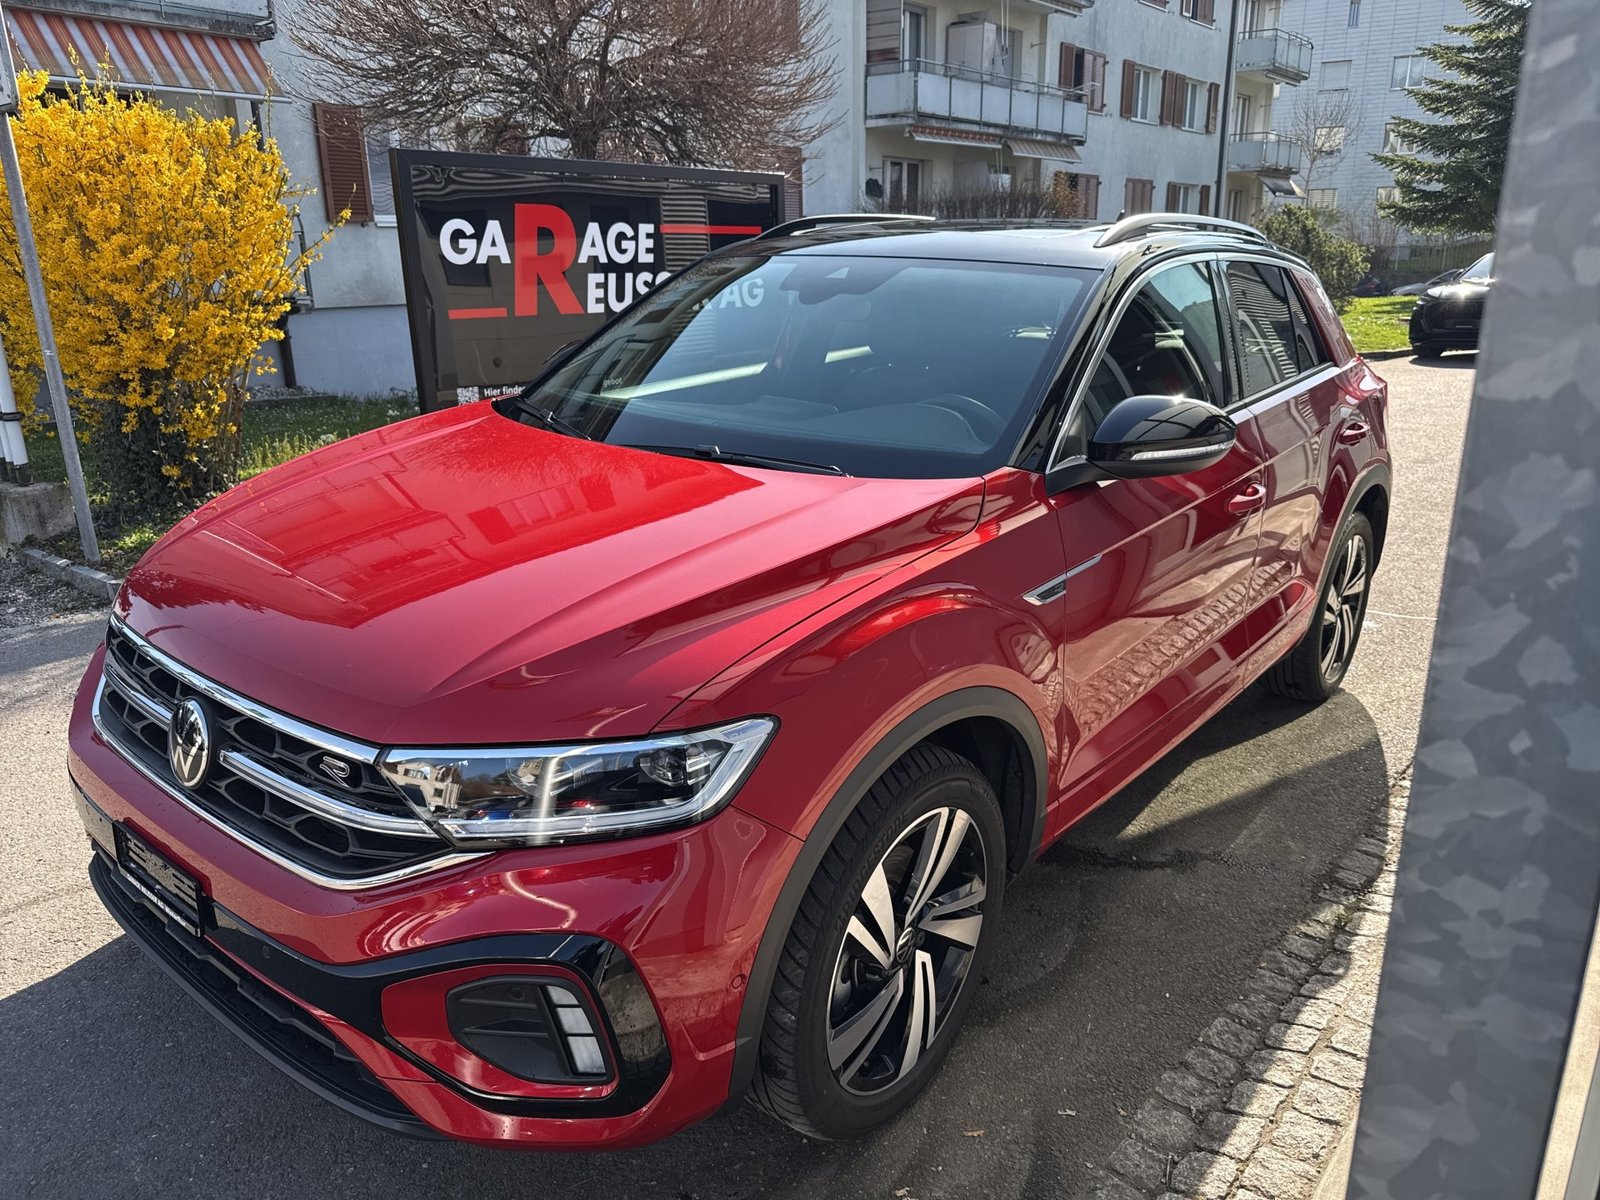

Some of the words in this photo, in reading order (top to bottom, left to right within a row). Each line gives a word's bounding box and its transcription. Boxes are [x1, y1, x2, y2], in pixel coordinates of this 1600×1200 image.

[719, 277, 764, 309] AG
[484, 387, 501, 397] Hier
[319, 755, 350, 788] R
